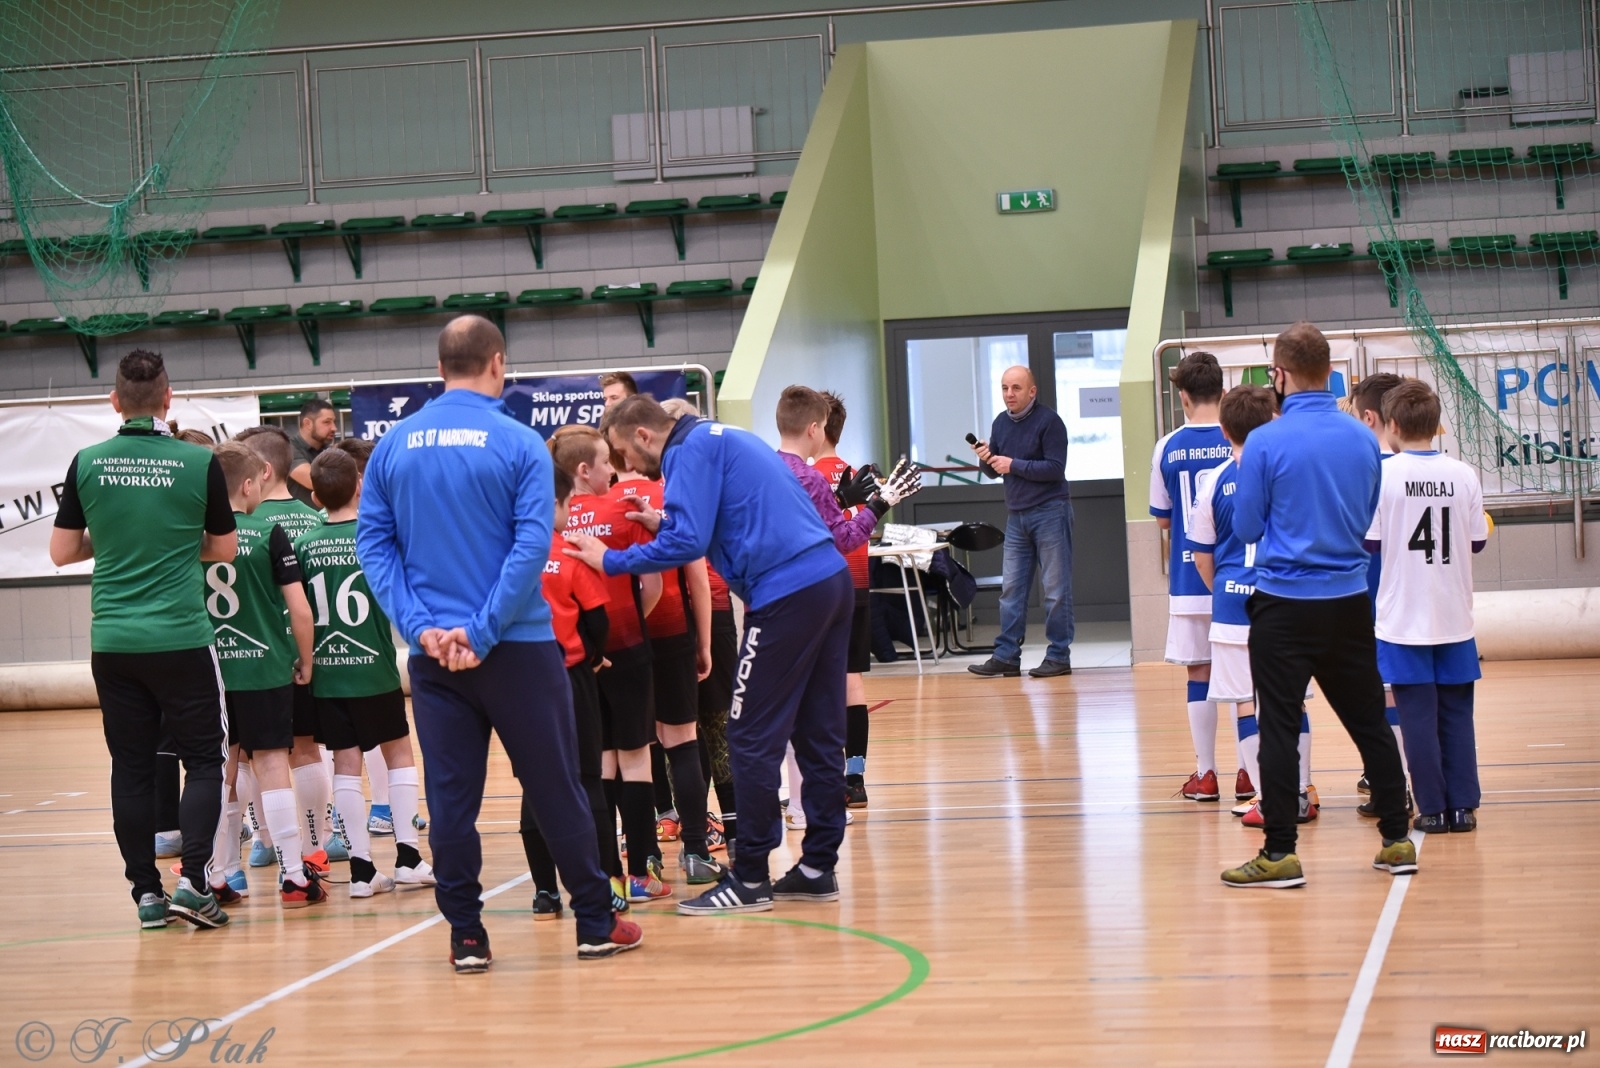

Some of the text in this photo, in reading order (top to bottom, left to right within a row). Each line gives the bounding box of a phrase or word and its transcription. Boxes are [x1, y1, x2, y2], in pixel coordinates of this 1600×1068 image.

[532, 391, 563, 404] Sklep
[531, 404, 605, 427] MW SP
[407, 428, 488, 449] LKS 07 MARKOWICE
[1168, 444, 1233, 463] UNIA RACIBÓRZ
[1495, 430, 1600, 467] kibic
[92, 457, 135, 466] AKADEMIA
[103, 465, 146, 474] MŁODEGO
[98, 473, 175, 488] TWORKÓW
[1405, 481, 1454, 497] MIKOŁAJ
[581, 511, 595, 525] 07
[237, 528, 261, 538] ARSKA
[1408, 506, 1451, 564] 41
[335, 537, 357, 545] PIŁKA
[306, 553, 361, 569] TWORKÓ
[206, 562, 240, 619] 8
[308, 570, 369, 627] 16
[217, 637, 238, 648] K.K
[328, 643, 350, 654] K.K
[218, 649, 264, 659] LEMENTE
[730, 626, 761, 720] GIVOVA
